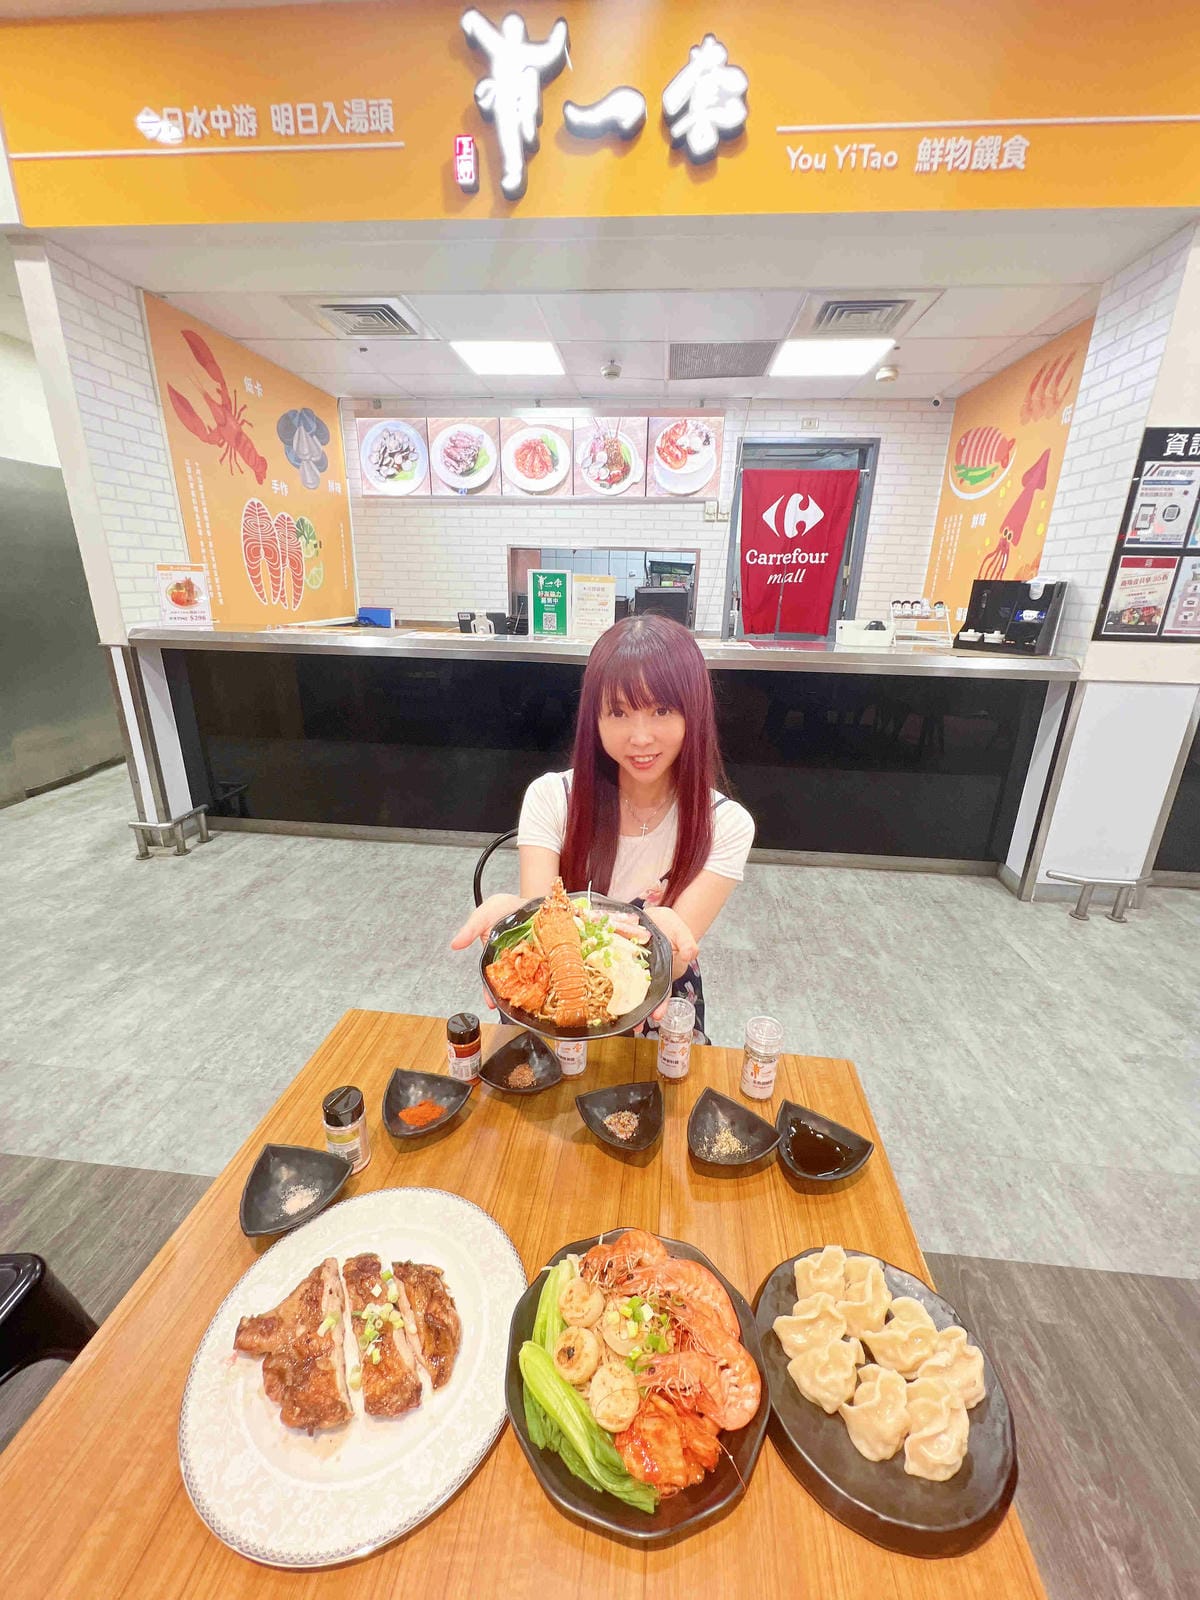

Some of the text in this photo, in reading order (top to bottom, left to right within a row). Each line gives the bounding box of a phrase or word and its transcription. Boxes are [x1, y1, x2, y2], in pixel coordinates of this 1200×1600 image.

[270, 98, 394, 136] 明日入湯頭
[786, 143, 898, 171] You YiTao
[745, 548, 829, 566] Carrefour
[766, 568, 806, 586] mall
